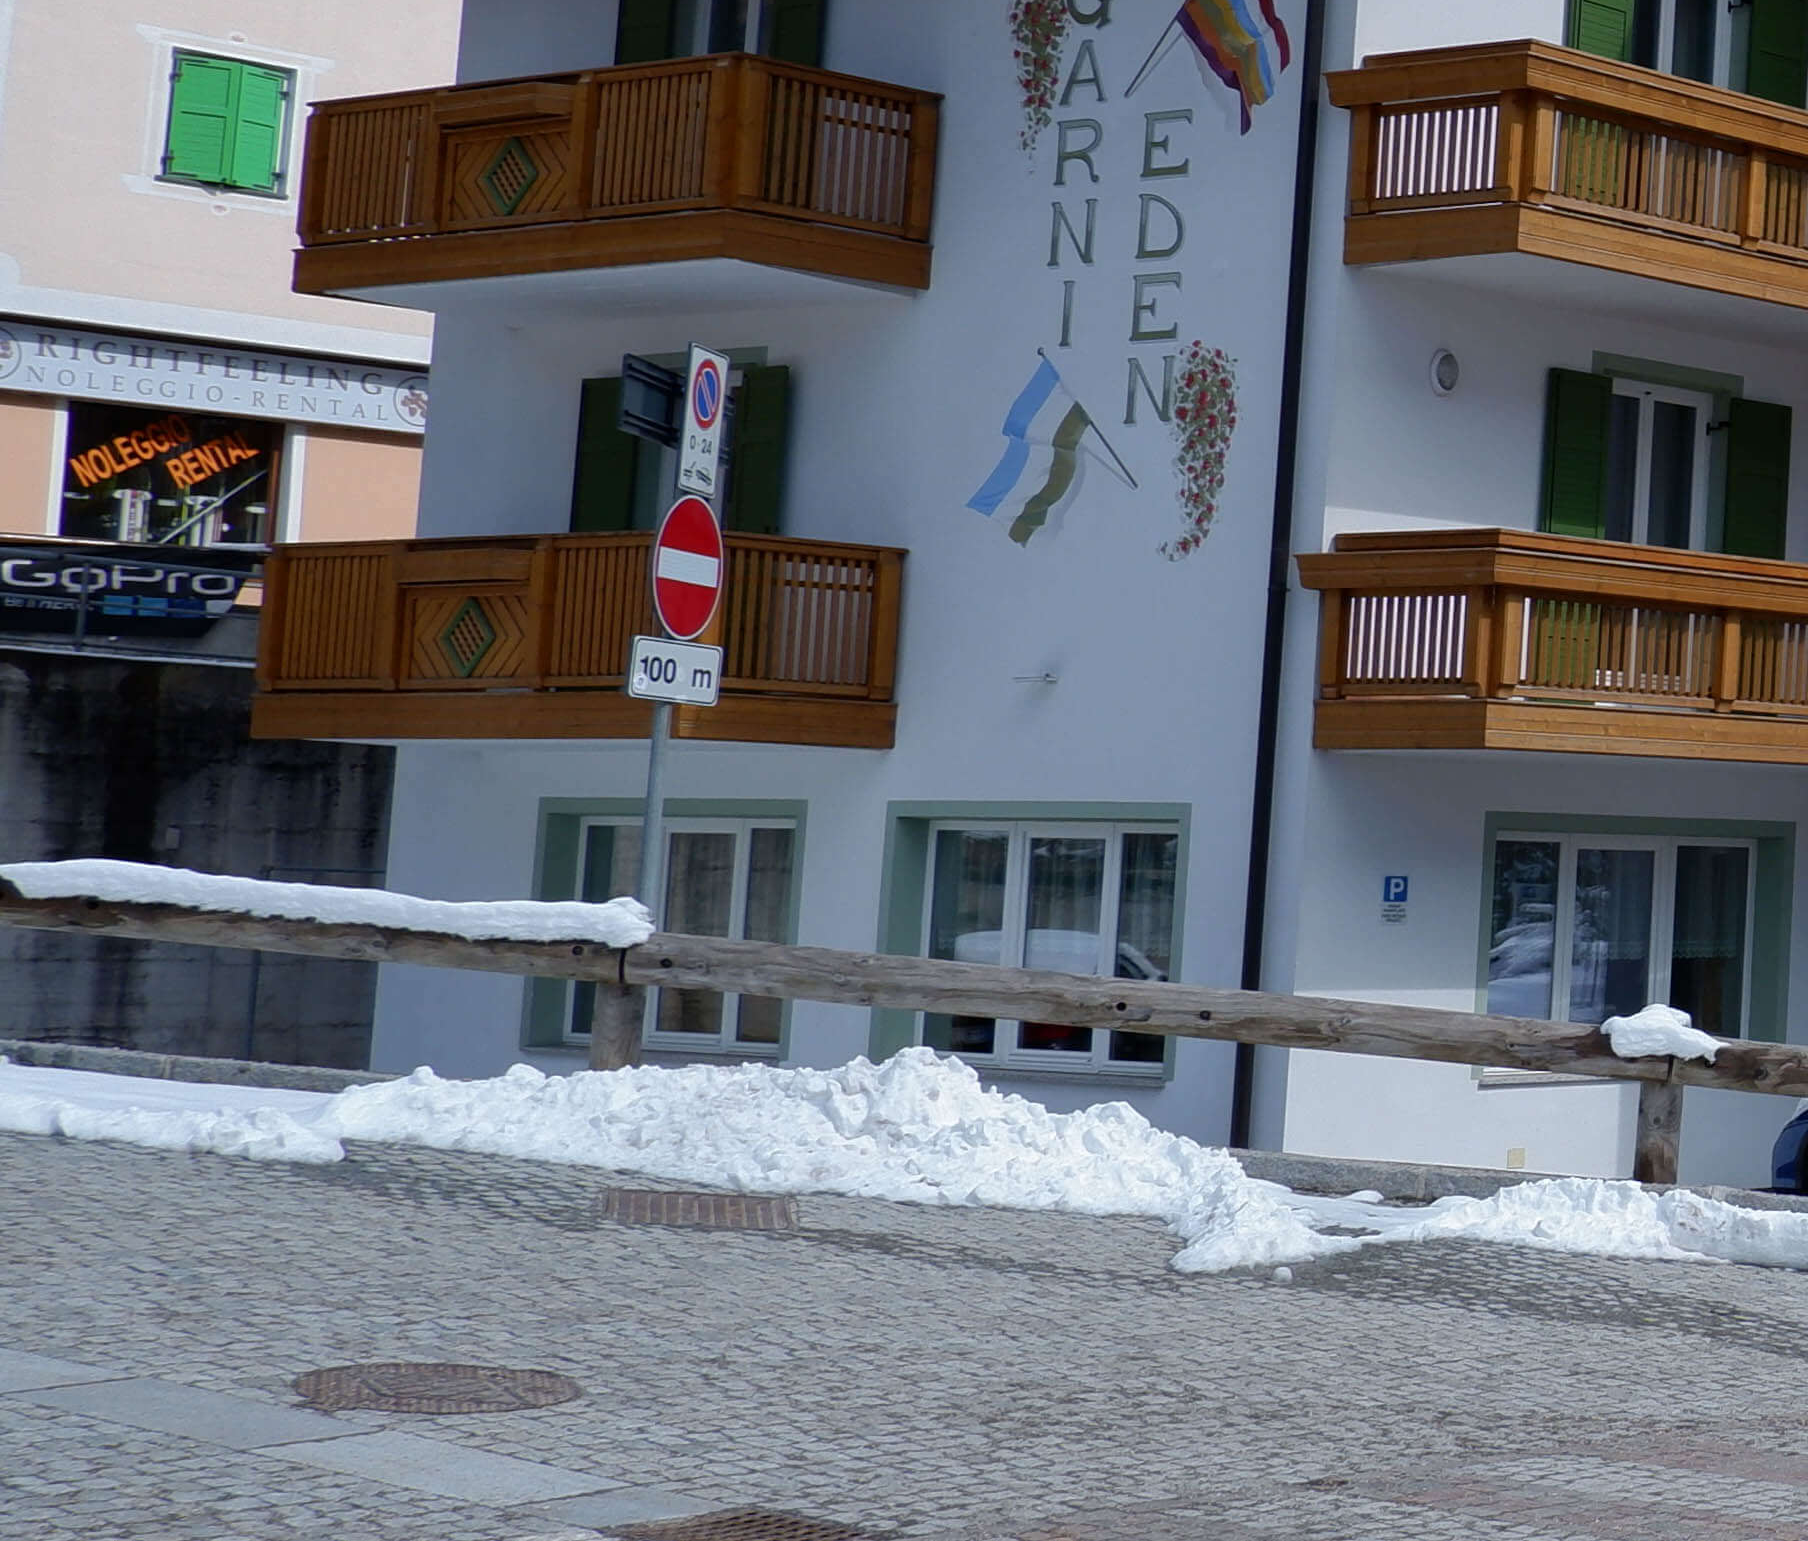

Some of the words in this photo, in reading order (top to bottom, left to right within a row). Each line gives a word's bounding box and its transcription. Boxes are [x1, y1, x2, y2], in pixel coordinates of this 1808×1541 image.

[1124, 109, 1193, 425] EDEN
[69, 414, 192, 488] NOLEGGIO
[165, 430, 260, 490] RENTAL
[1, 559, 236, 595] GoPro
[639, 655, 677, 685] 100
[692, 666, 712, 689] m
